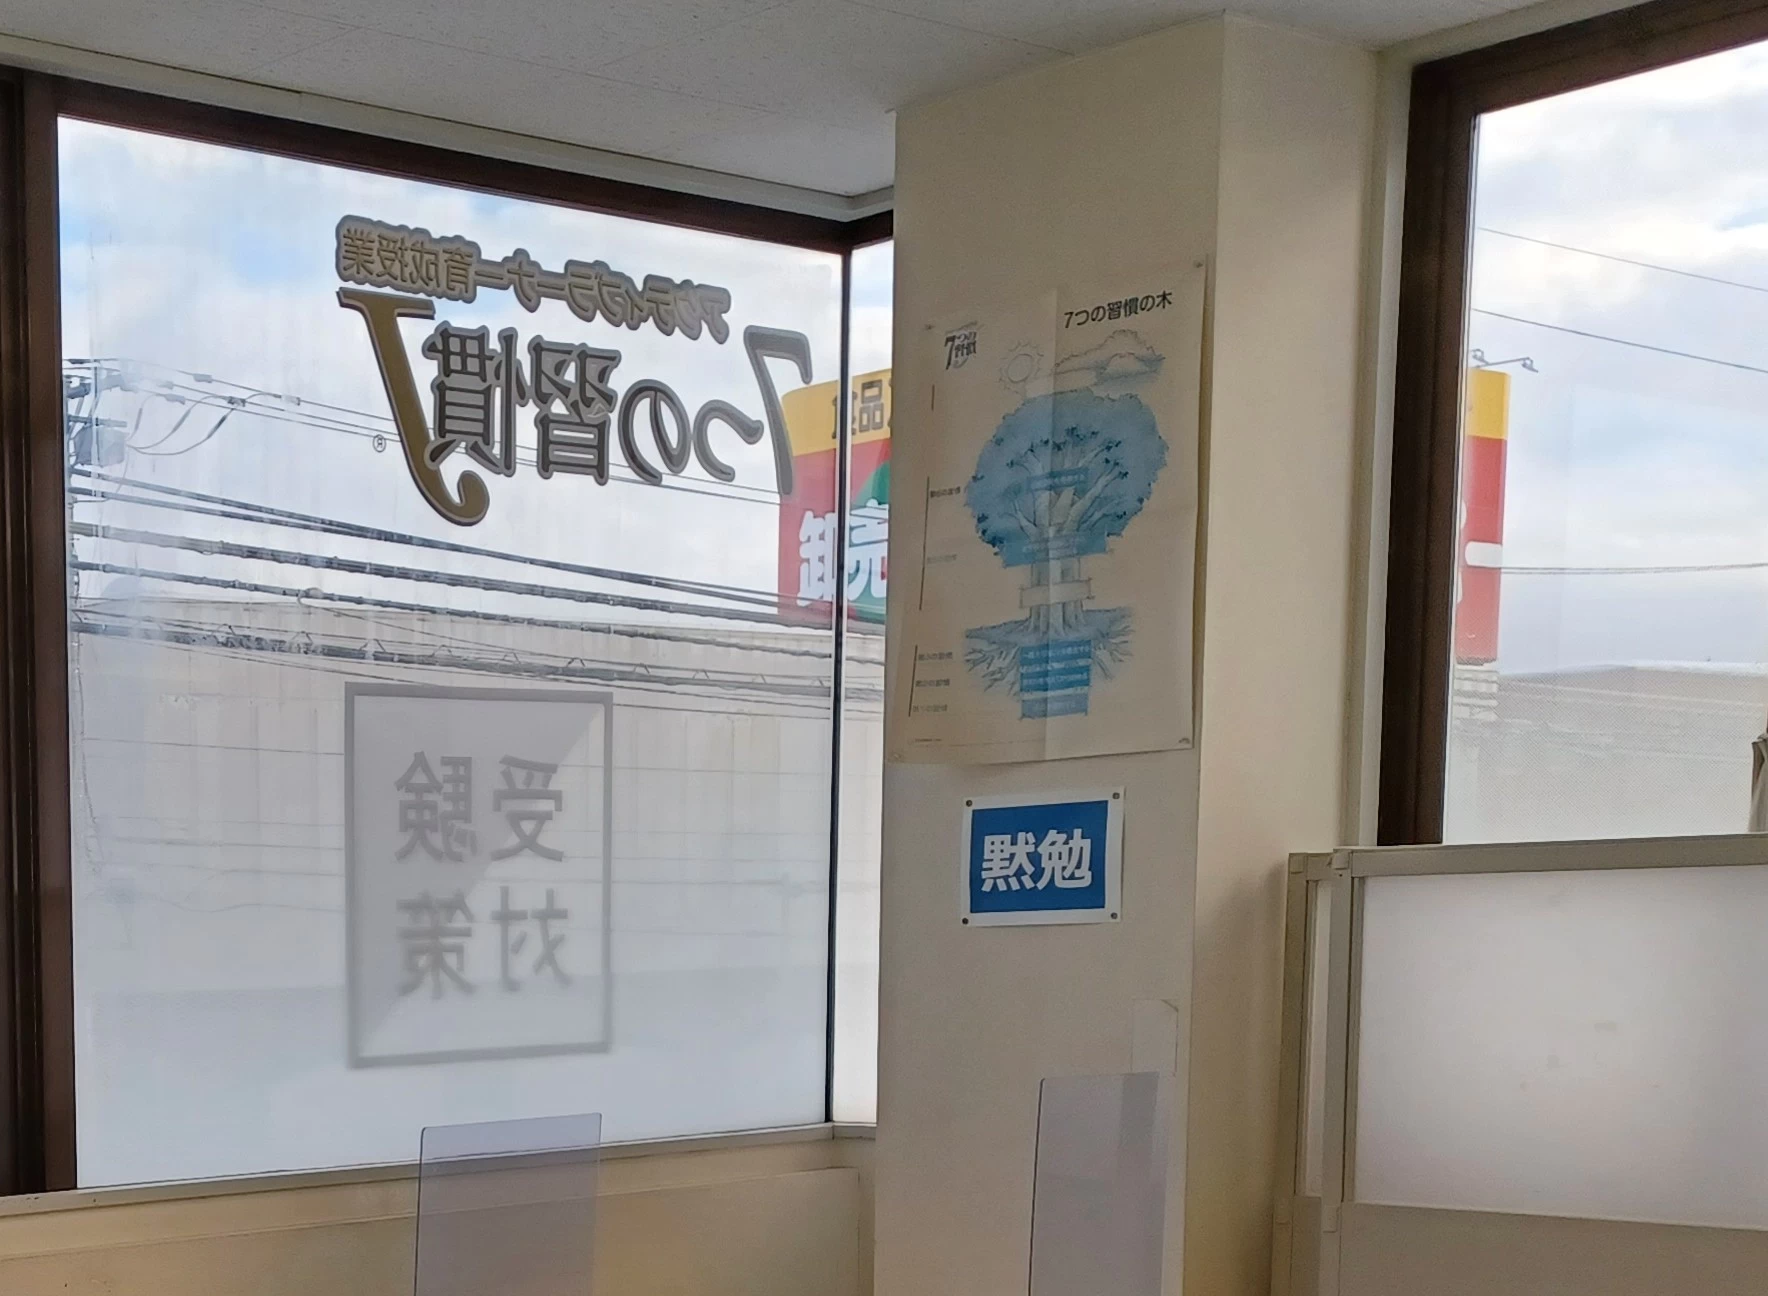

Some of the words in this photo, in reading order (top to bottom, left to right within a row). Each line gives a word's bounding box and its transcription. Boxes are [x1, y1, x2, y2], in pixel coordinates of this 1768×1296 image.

[1064, 290, 1172, 328] 7つの習慣の木
[981, 828, 1093, 892] 黙勉
